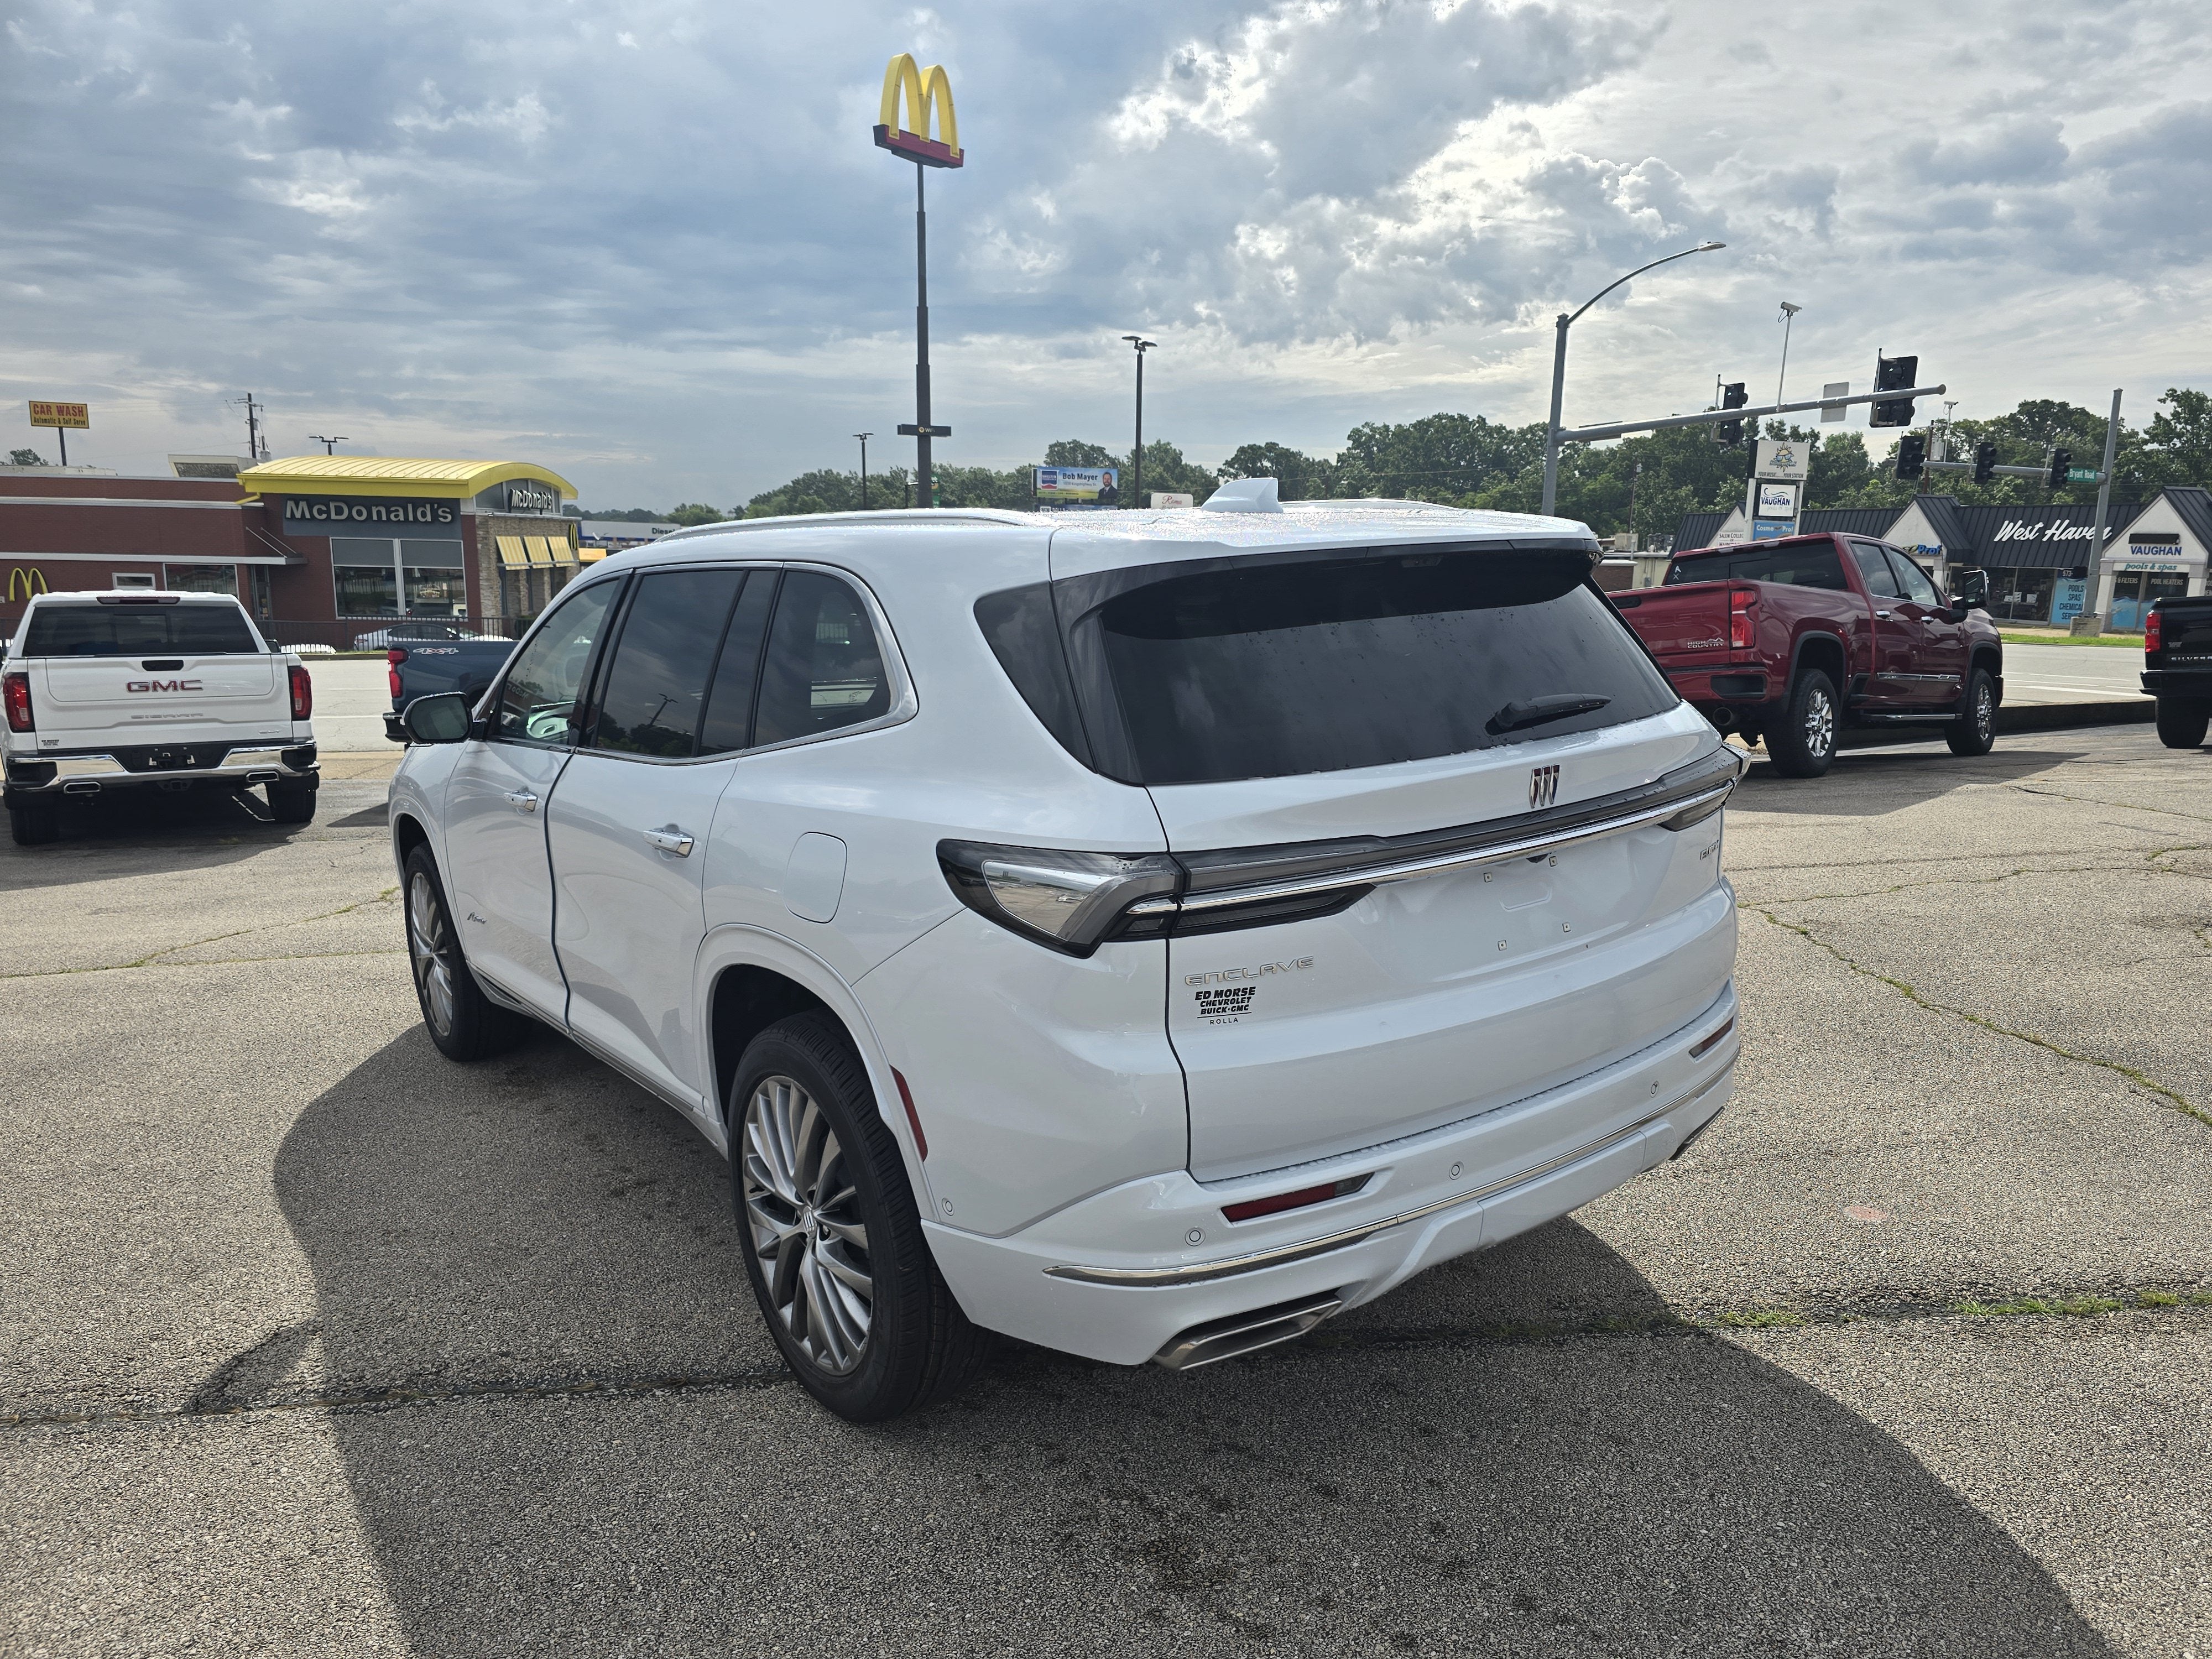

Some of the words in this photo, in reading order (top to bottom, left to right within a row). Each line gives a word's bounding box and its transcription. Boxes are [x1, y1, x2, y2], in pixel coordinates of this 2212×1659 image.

[33, 404, 53, 416] CAR
[56, 405, 84, 417] WASH
[1077, 473, 1098, 482] Mayer
[2069, 468, 2083, 480] Bryant
[2084, 469, 2095, 479] Road
[510, 489, 553, 510] McDonald's
[1761, 497, 1790, 506] VAUGHAN
[285, 500, 453, 523] McDonald's
[1994, 520, 2044, 542] West
[1917, 544, 1942, 555] Prof
[2130, 546, 2182, 556] VAUGHAN
[2125, 563, 2148, 571] pools
[2157, 564, 2178, 572] spas
[127, 680, 204, 693] GMC
[1185, 956, 1314, 986] ENCLAVE
[1194, 990, 1212, 1000] ED
[1213, 987, 1256, 999] MORSE
[1200, 997, 1252, 1008] CHEVROLET
[1209, 1017, 1239, 1025] ROLLA
